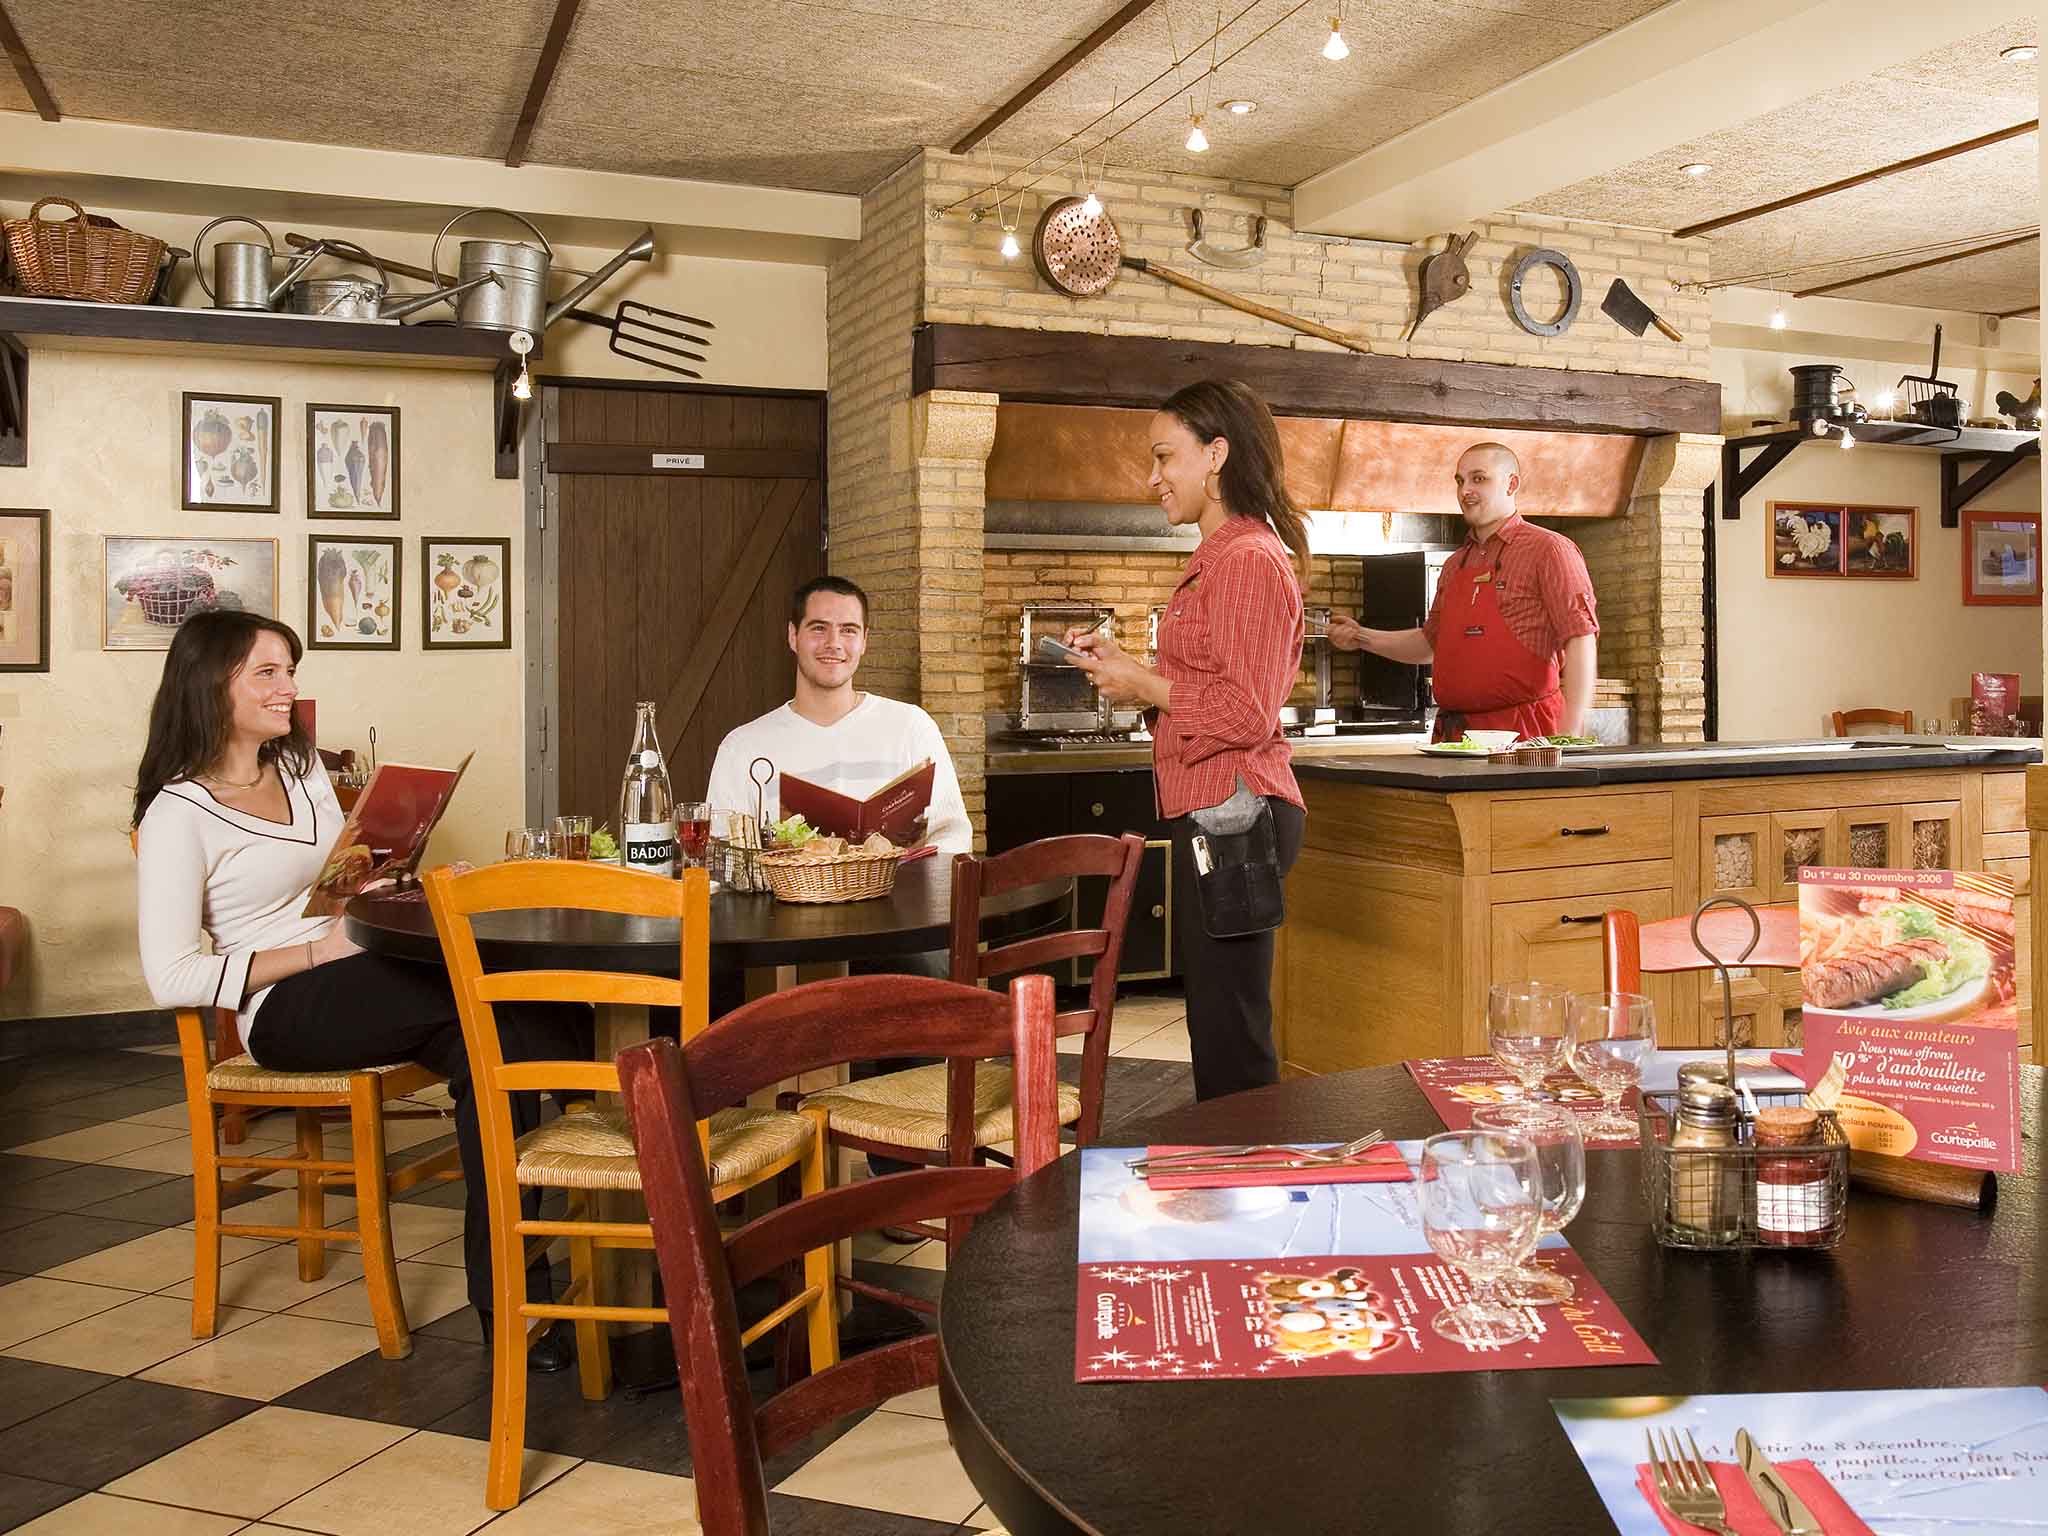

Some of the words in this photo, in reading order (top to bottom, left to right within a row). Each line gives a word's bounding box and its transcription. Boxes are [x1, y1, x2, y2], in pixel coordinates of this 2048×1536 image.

[666, 456, 690, 464] PRIVÉ
[1803, 870, 1817, 879] Du
[1833, 872, 1846, 880] au
[1848, 871, 1861, 880] 30
[1863, 872, 1914, 883] novembre
[1836, 1019, 1867, 1036] Avis
[1871, 1027, 1900, 1039] aux
[1904, 1029, 1975, 1045] amateurs
[1858, 1041, 1886, 1054] Nous
[1889, 1046, 1913, 1057] vous
[1915, 1045, 1953, 1061] offrons
[1876, 1055, 1986, 1083] d'andouillette
[1851, 1072, 1874, 1086] plus
[1877, 1074, 1902, 1087] dans
[1905, 1078, 1931, 1091] votre
[1933, 1081, 1978, 1095] assiette.
[1930, 1131, 1998, 1150] Courtepaille
[1572, 1324, 1625, 1353] Grill
[1883, 1466, 2018, 1482] Courtepaille
